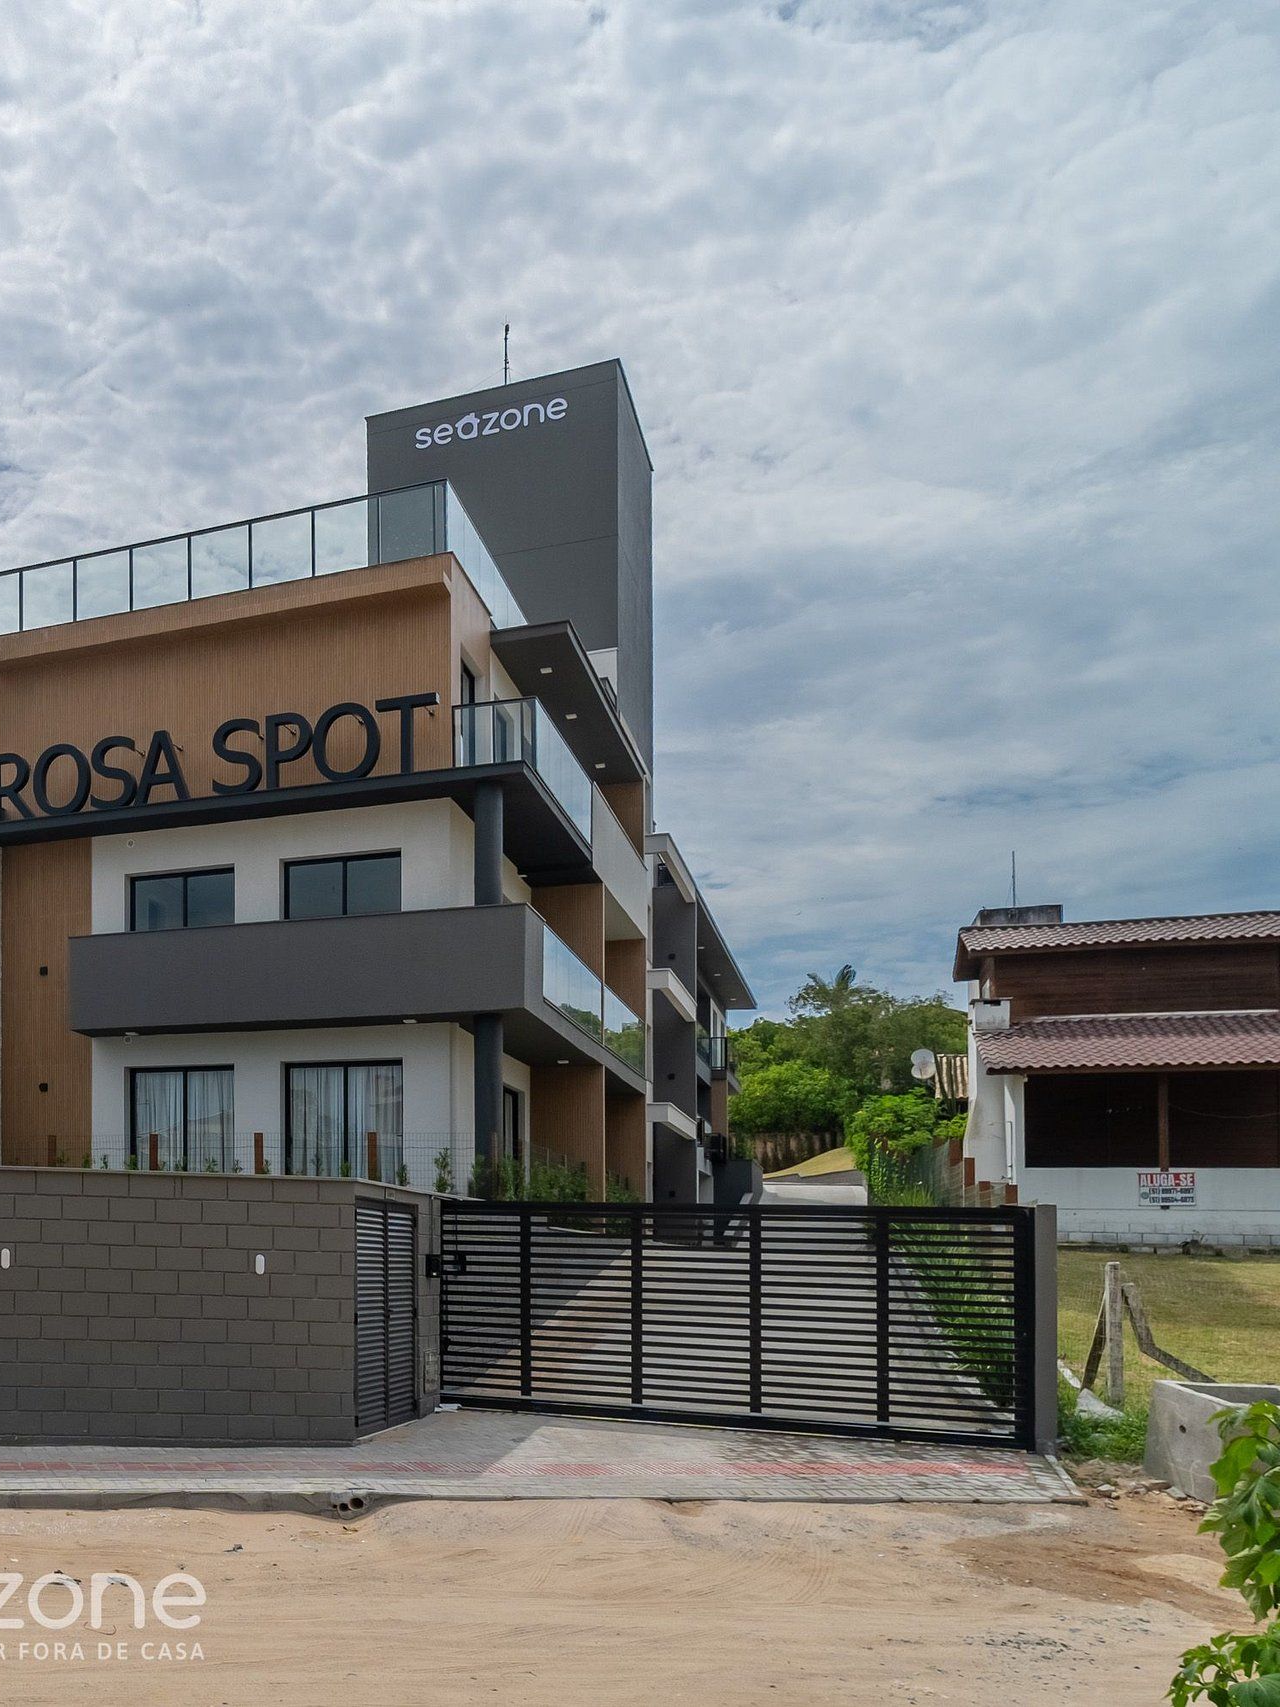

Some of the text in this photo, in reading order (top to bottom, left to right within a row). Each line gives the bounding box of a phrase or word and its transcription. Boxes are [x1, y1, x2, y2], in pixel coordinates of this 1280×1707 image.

[415, 398, 568, 449] seazone
[212, 692, 440, 795] SPOT
[1140, 1173, 1194, 1186] ALUGA-SE
